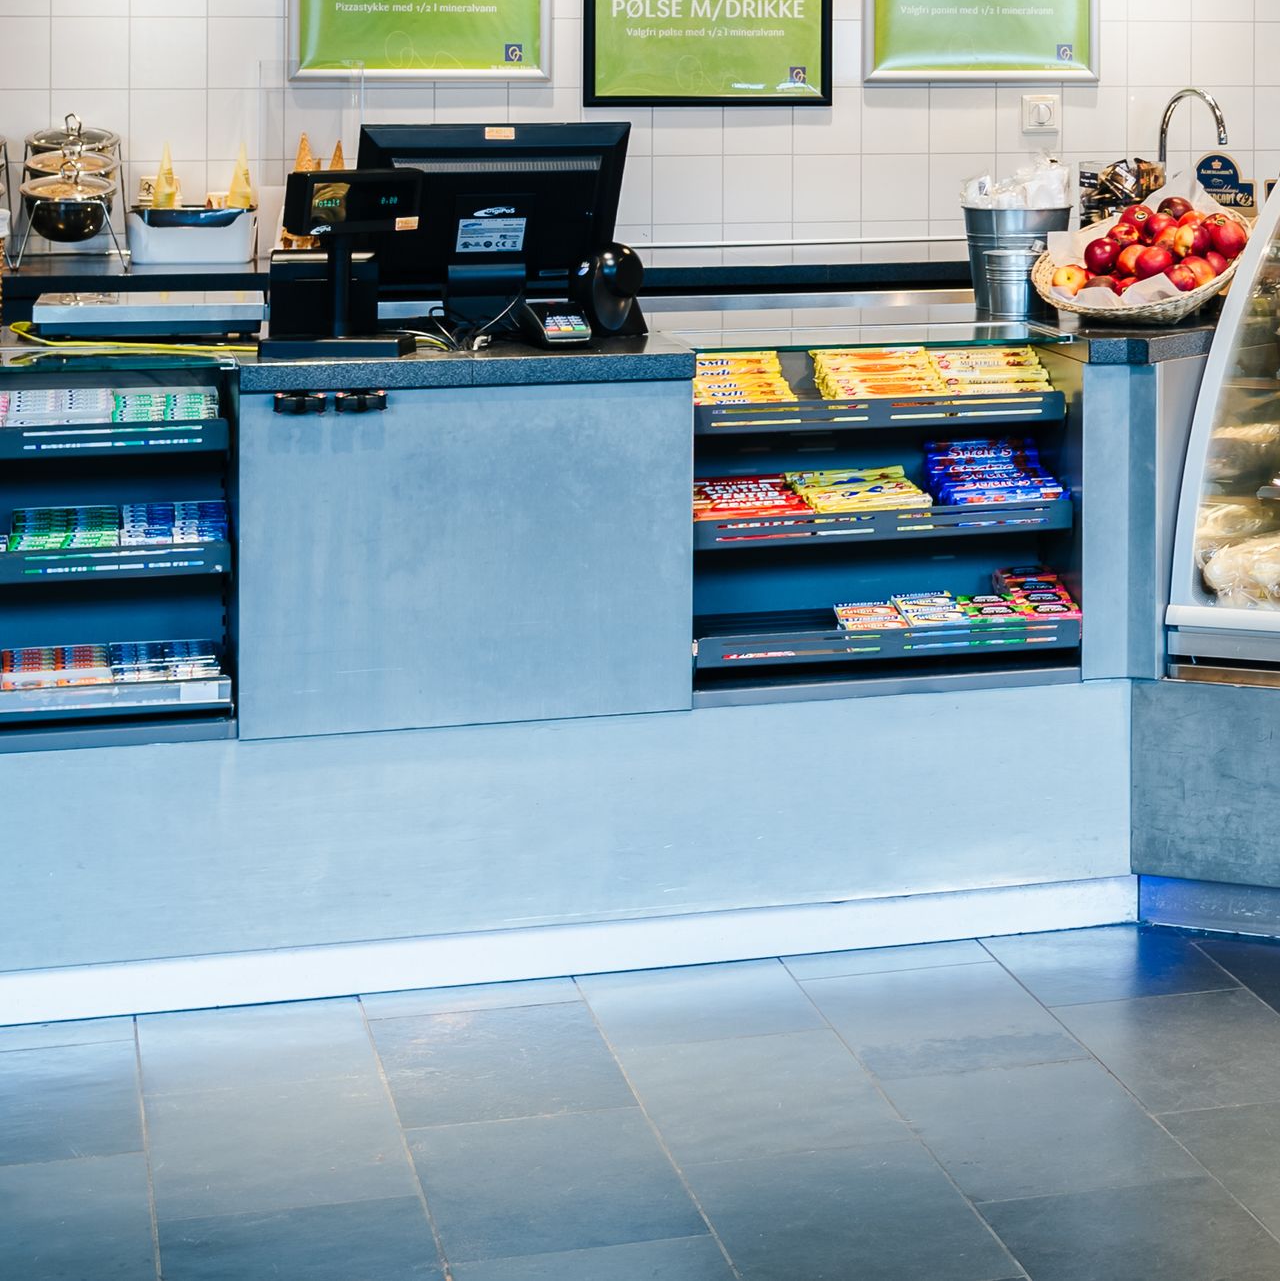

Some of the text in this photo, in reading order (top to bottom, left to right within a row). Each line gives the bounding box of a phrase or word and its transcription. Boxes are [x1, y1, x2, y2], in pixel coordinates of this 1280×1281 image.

[335, 2, 390, 14] Pizzastykke
[392, 3, 413, 13] med
[416, 3, 432, 14] 1/2
[439, 3, 497, 13] mineralvann
[931, 6, 958, 16] panini
[959, 6, 978, 15] med
[626, 27, 657, 39] Valgfri
[685, 28, 705, 37] med
[706, 29, 722, 38] 1/2
[729, 28, 785, 37] mineralvann
[315, 199, 340, 207] Totalt
